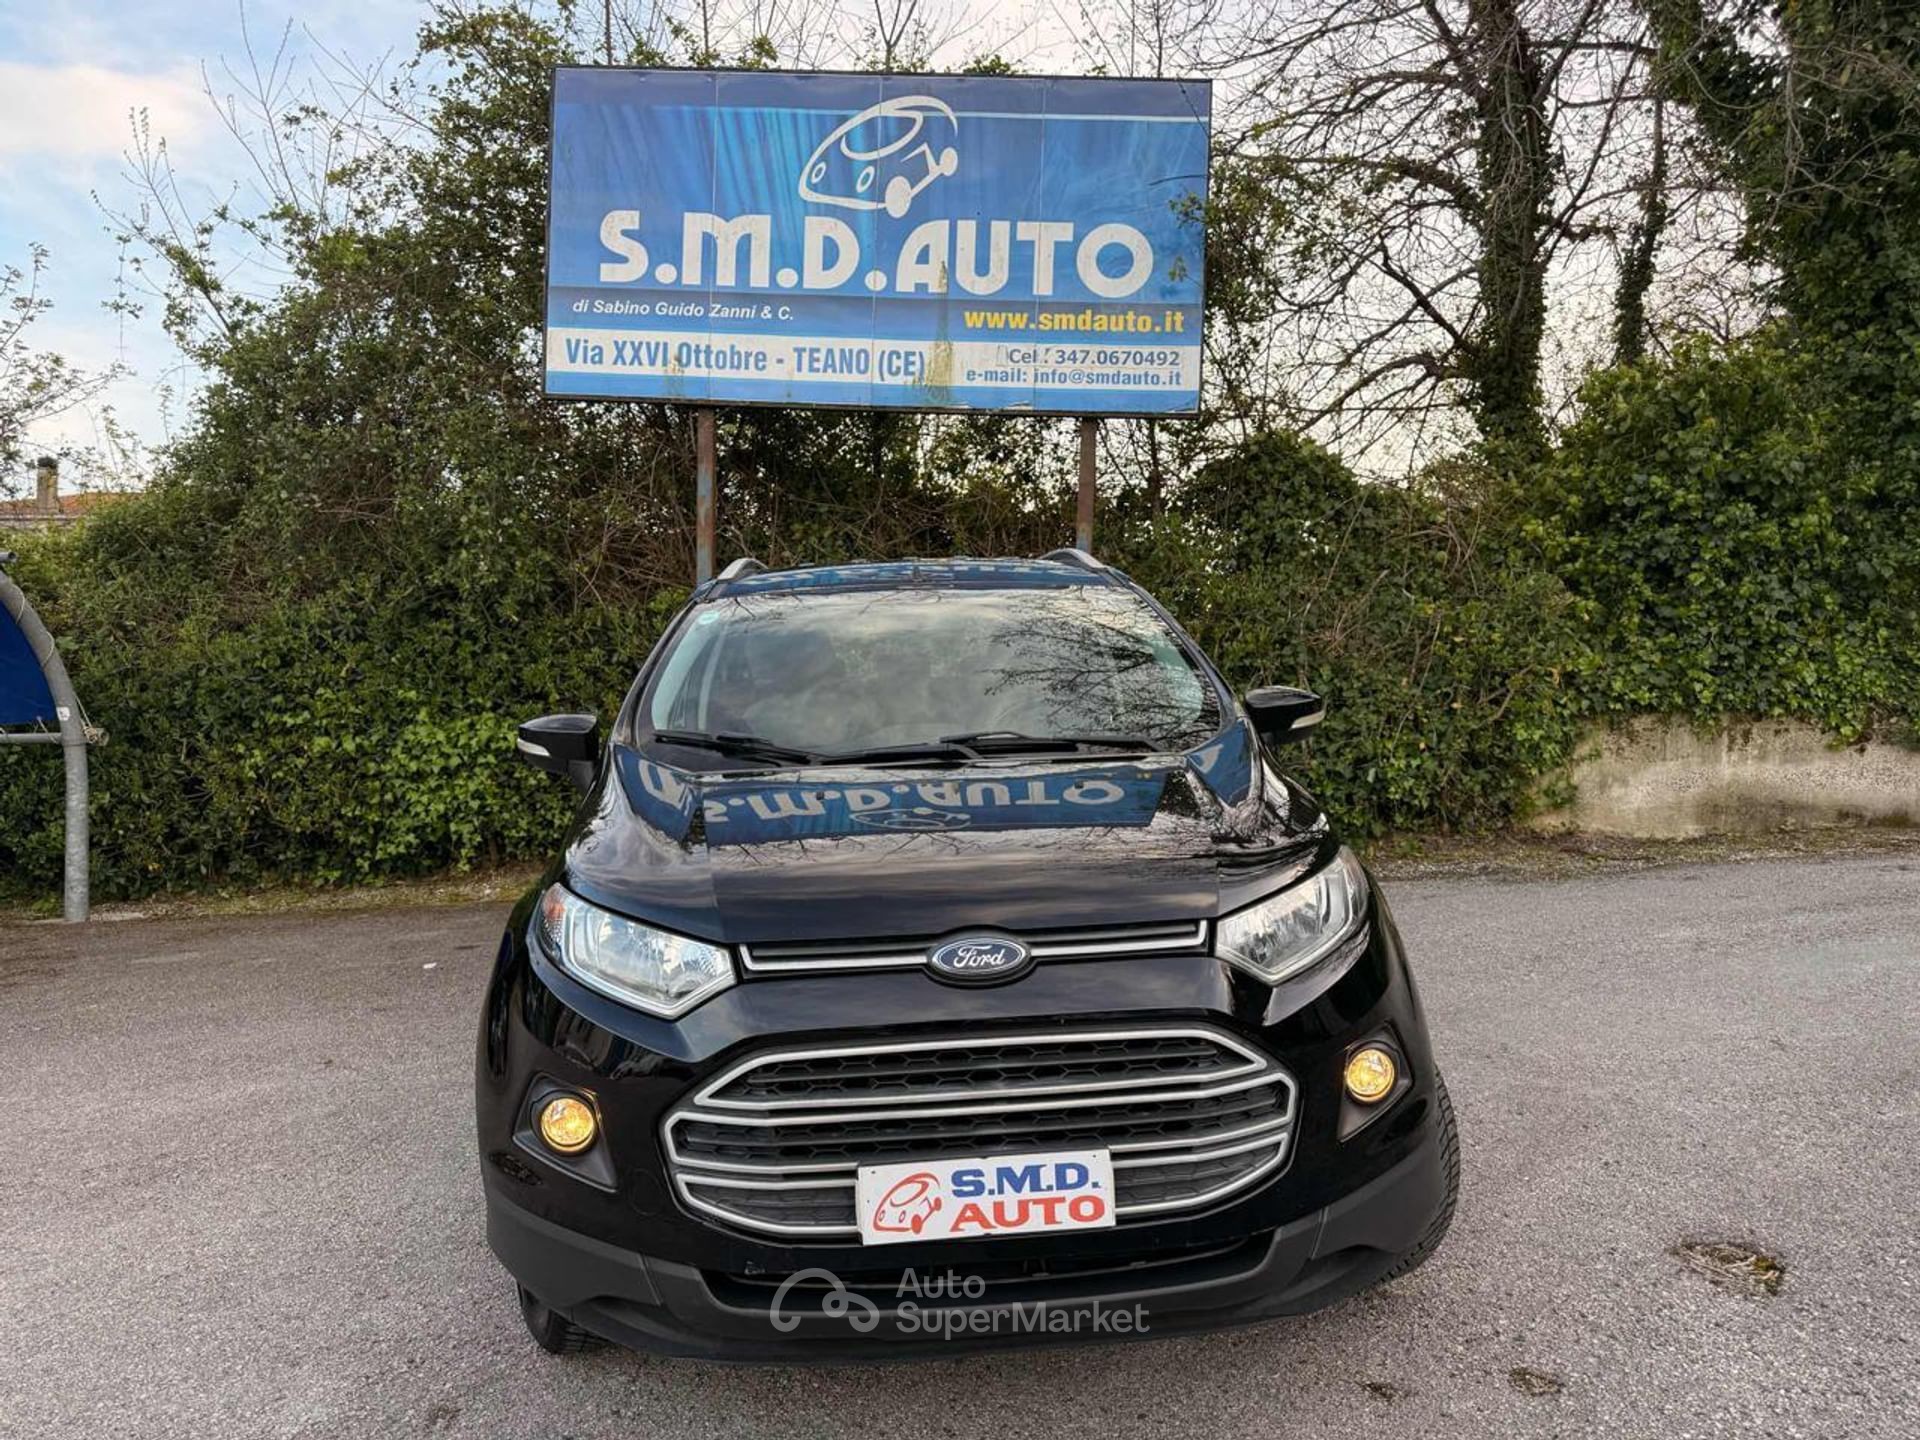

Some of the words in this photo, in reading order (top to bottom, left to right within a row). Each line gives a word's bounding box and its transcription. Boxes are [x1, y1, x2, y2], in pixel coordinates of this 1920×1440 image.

[573, 300, 588, 313] di
[593, 300, 650, 315] Sabino
[655, 302, 704, 317] Guido
[709, 304, 756, 319] Zanni
[761, 306, 773, 319] &
[778, 306, 794, 320] C.
[964, 310, 1184, 332] www.smdauto.it
[566, 338, 603, 365] Via
[613, 340, 669, 367] XXVI
[677, 342, 768, 372] Ottobre
[793, 347, 870, 375] TEANO
[878, 350, 925, 382] (CE)
[1055, 351, 1180, 366] 347.0670492
[966, 368, 1027, 383] e-mail:
[1034, 369, 1182, 386] info@smdauto.it
[953, 945, 1006, 968] Ford
[950, 1162, 1100, 1198] S.M.D.
[949, 1194, 1106, 1232] AUTO
